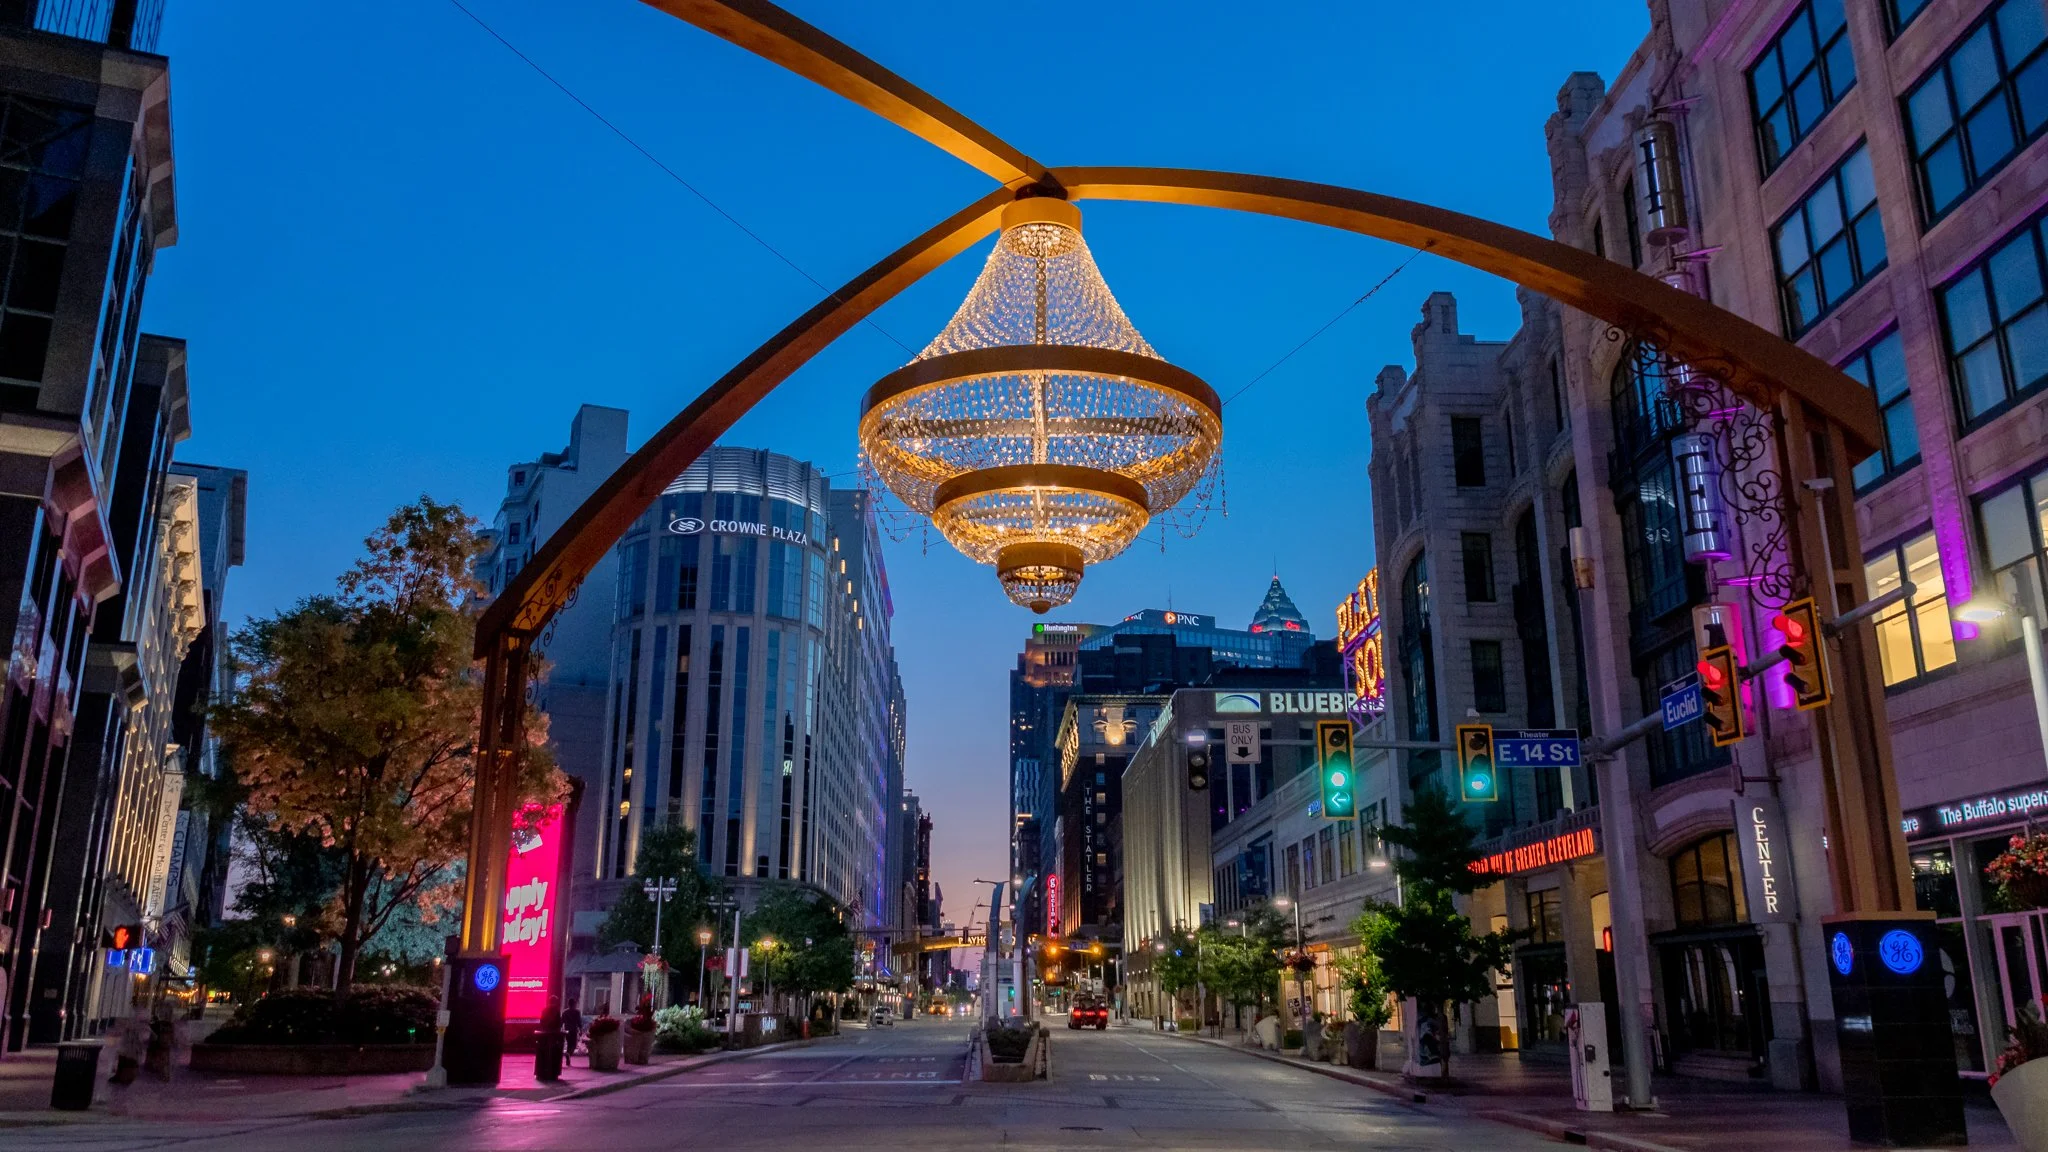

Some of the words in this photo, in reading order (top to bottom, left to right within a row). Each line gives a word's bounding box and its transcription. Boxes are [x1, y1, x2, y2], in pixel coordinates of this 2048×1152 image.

[709, 519, 767, 535] CROWNE
[772, 526, 808, 546] PLAZA
[1044, 624, 1077, 632] Huntington
[1177, 615, 1199, 626] PNC
[1666, 690, 1698, 723] Euclid
[1231, 735, 1253, 745] ONLY
[1232, 724, 1251, 734] BUS
[1499, 744, 1517, 762] E.
[1520, 744, 1545, 762] 14
[1549, 743, 1574, 761] St
[1940, 808, 1963, 825] The
[1963, 798, 2006, 820] Buffalo
[160, 814, 172, 844] Center
[1490, 854, 1503, 874] WAY
[1505, 851, 1513, 873] OF
[1515, 842, 1547, 872] GREATER
[1547, 828, 1595, 863] CLEVELAND
[1752, 807, 1779, 913] CENTER
[153, 855, 166, 887] Health
